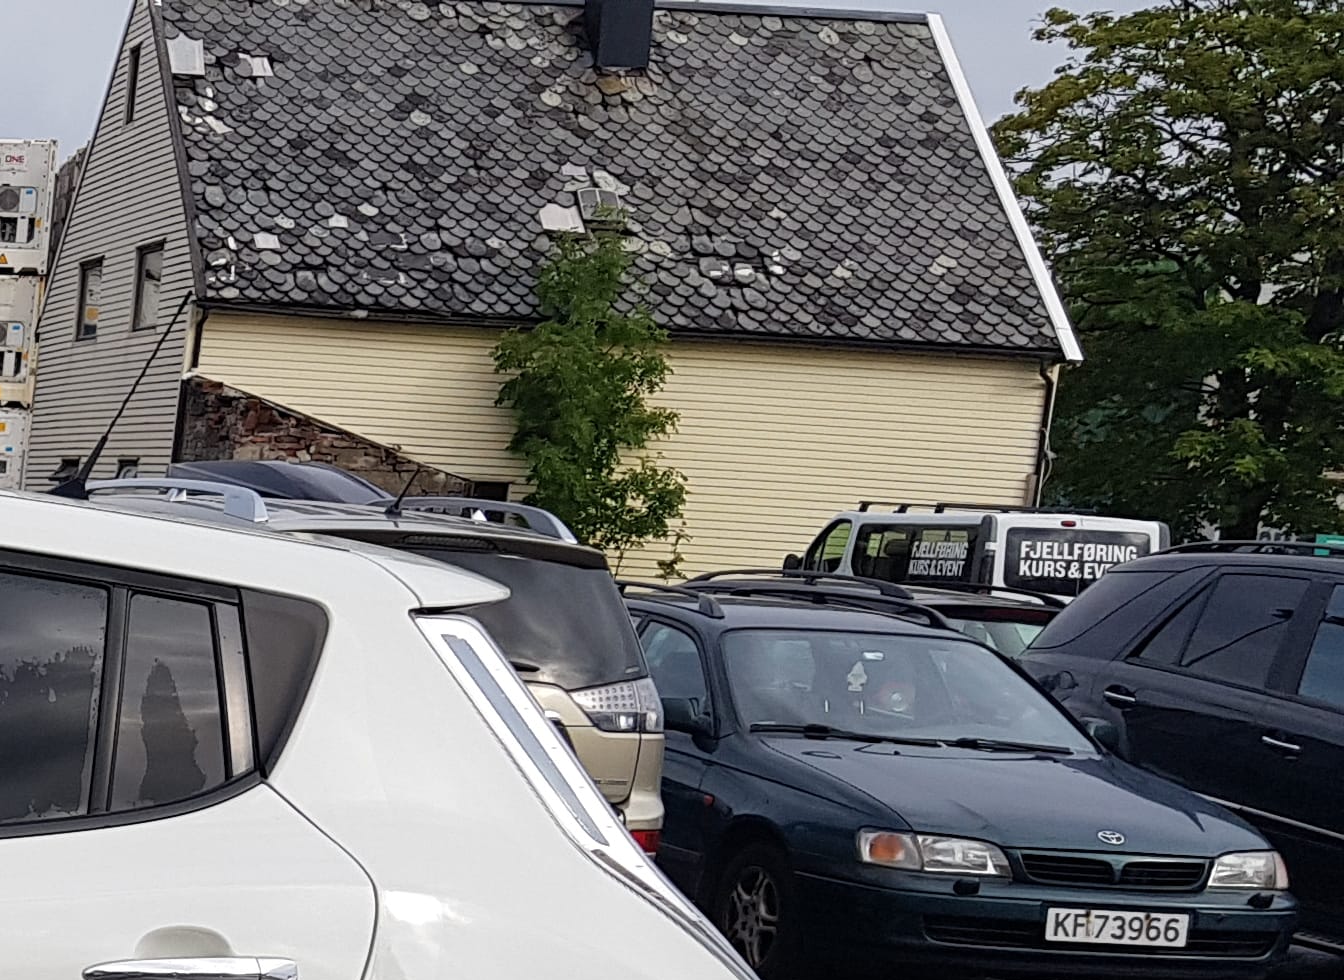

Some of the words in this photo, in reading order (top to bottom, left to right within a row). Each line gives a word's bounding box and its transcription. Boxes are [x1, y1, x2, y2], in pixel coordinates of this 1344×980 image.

[4, 155, 25, 163] ONE
[1020, 541, 1138, 563] FJELLFØRING
[1019, 560, 1067, 578] KURS
[1067, 561, 1083, 579] &
